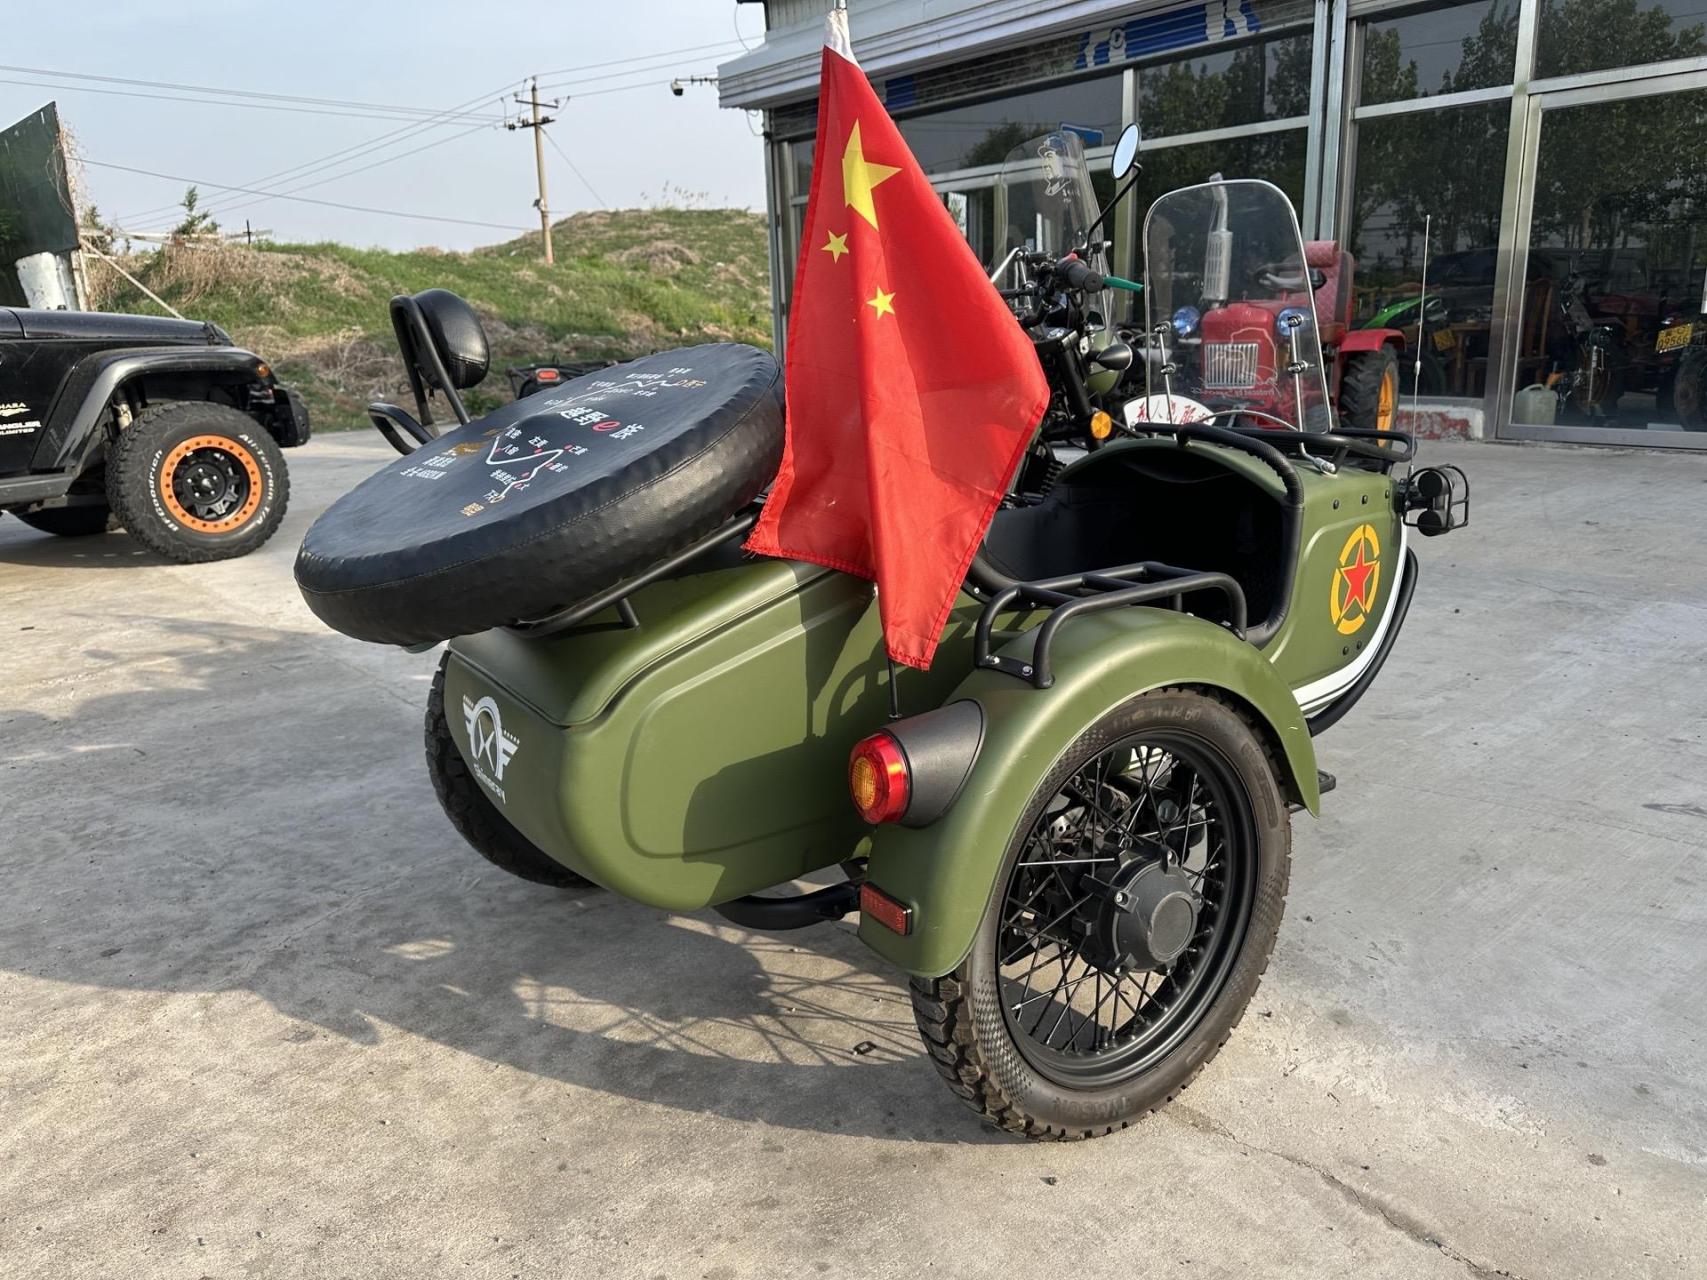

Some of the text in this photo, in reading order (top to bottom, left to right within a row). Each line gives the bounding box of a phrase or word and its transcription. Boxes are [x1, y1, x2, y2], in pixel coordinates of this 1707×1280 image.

[0, 428, 35, 436] LIMITED
[560, 406, 645, 440] 越野e族
[148, 449, 179, 531] BFGoodrich
[238, 434, 274, 500] All-Terrain
